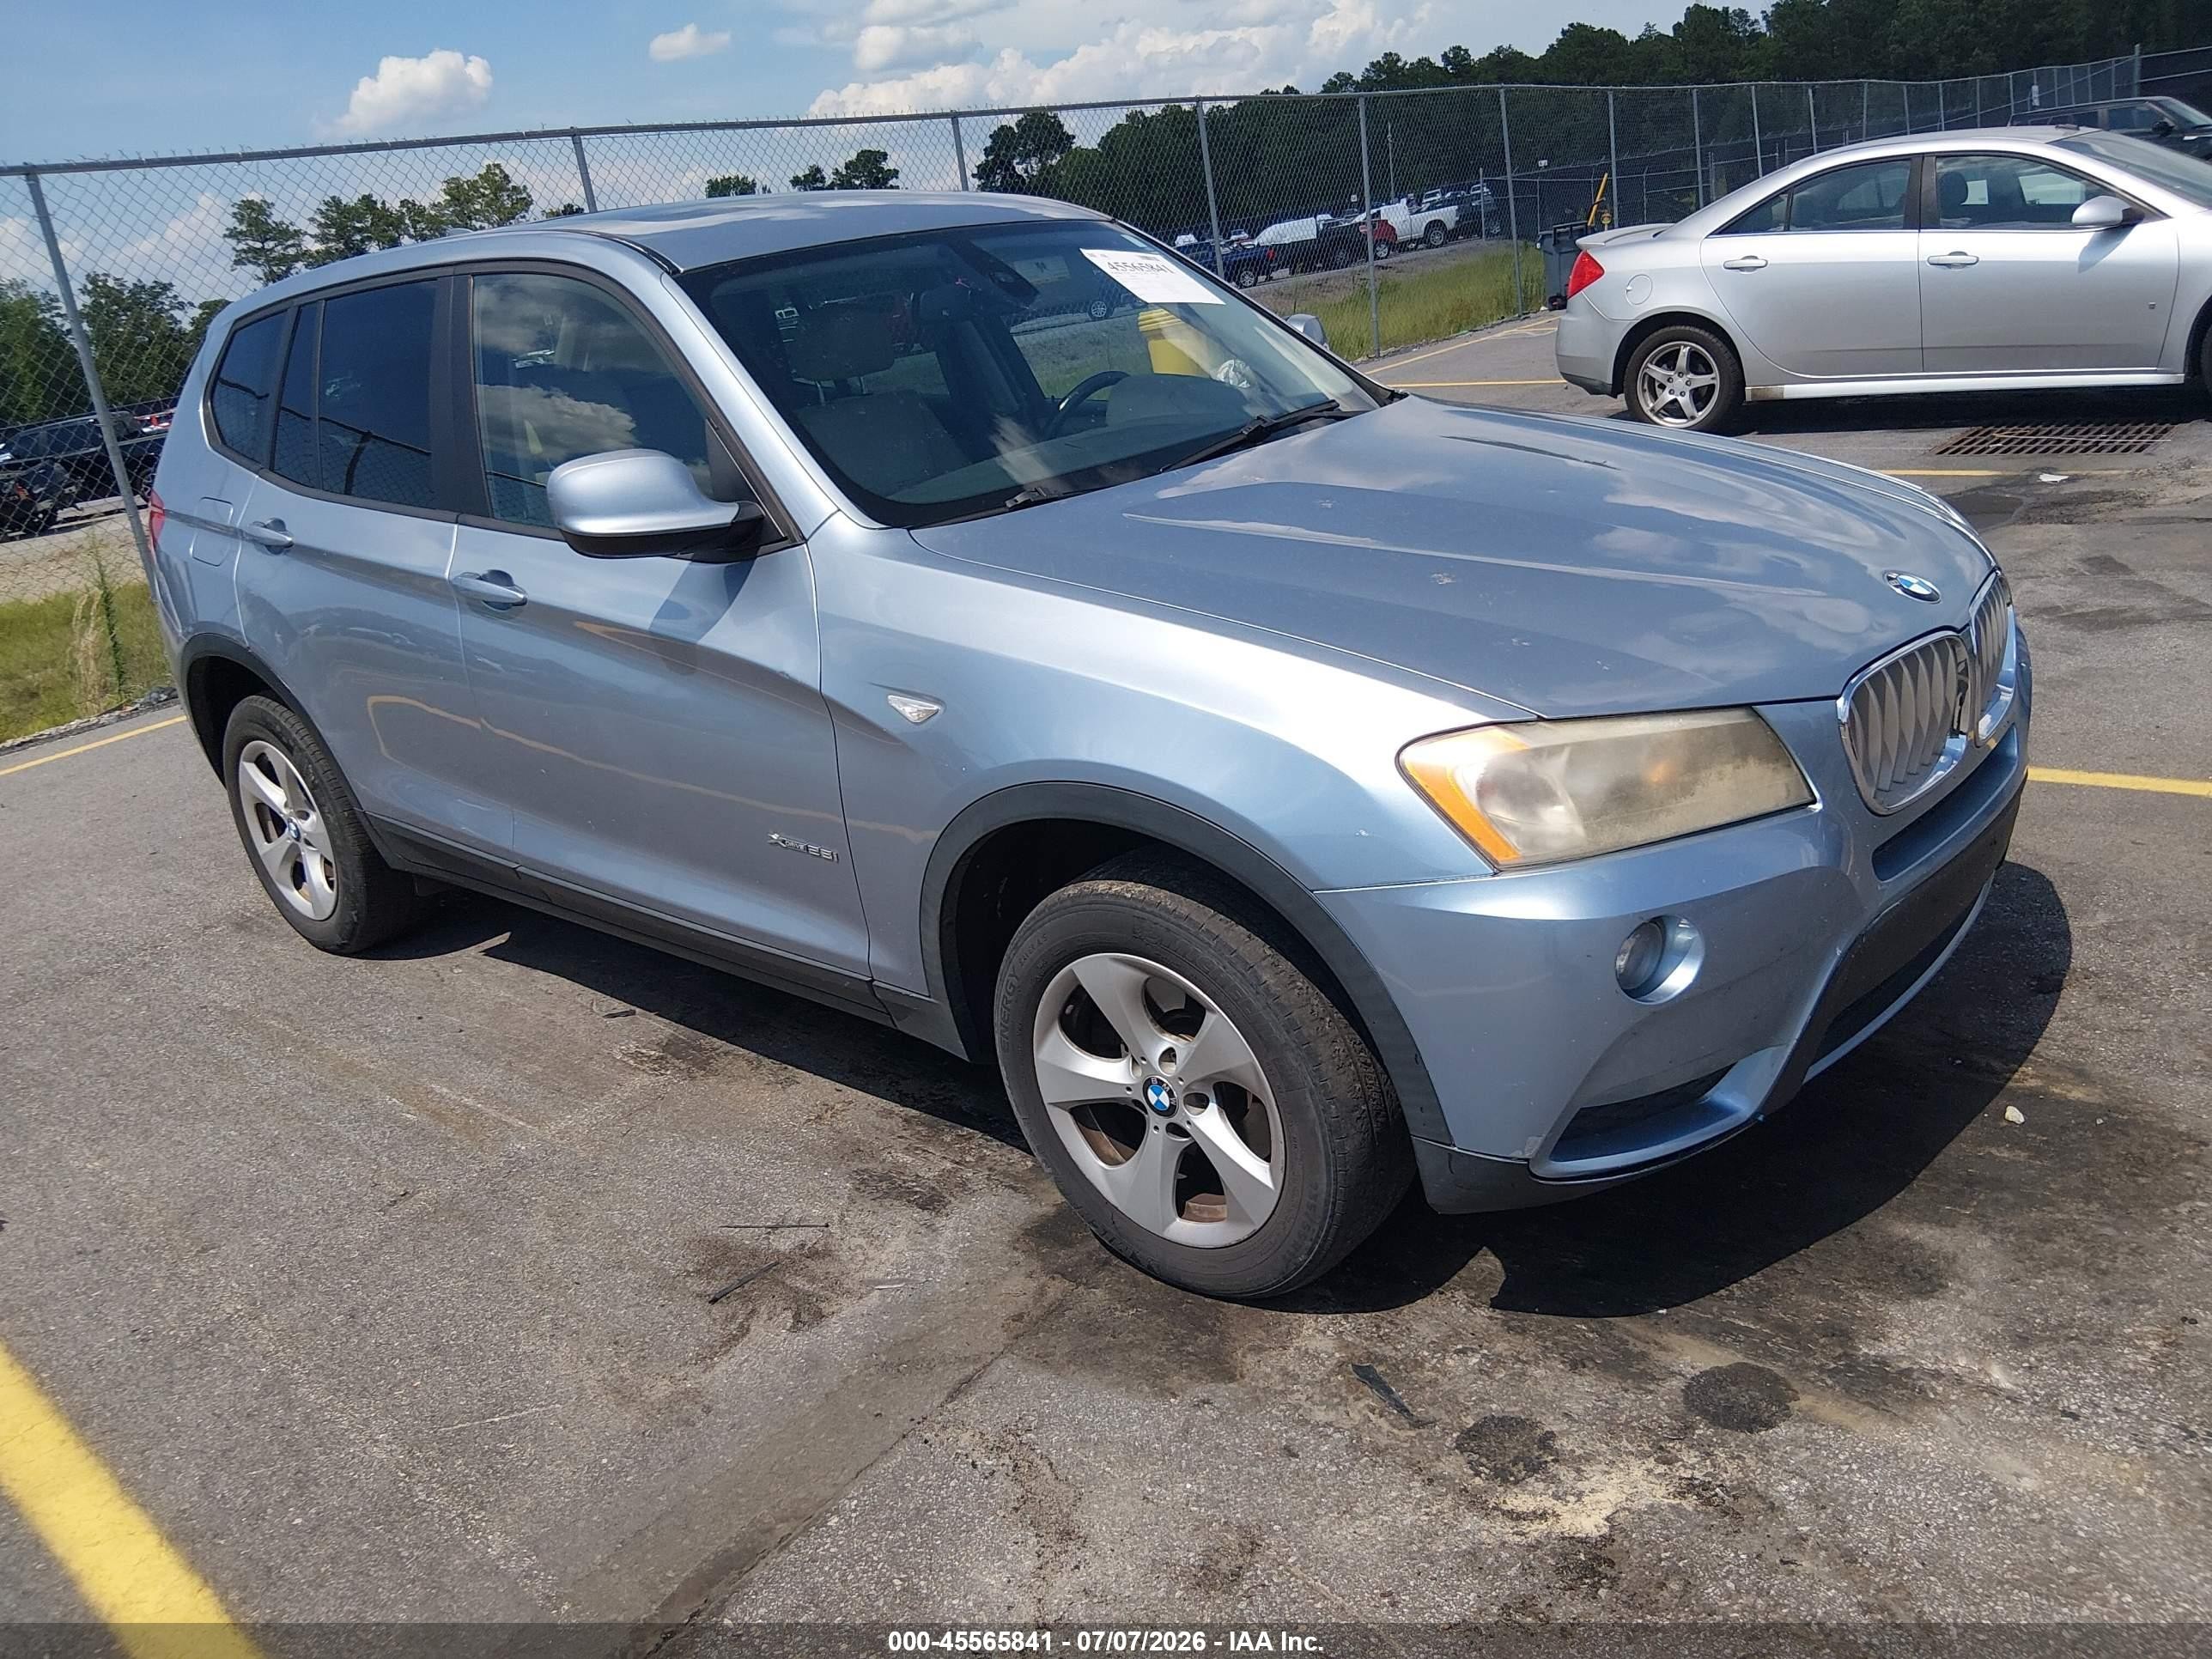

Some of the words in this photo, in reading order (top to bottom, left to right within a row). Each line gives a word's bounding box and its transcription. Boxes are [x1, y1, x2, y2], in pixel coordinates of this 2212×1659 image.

[1107, 261, 1176, 274] 45565841
[1000, 965, 1019, 1053] ENERGY
[1151, 1077, 1177, 1107] BMW
